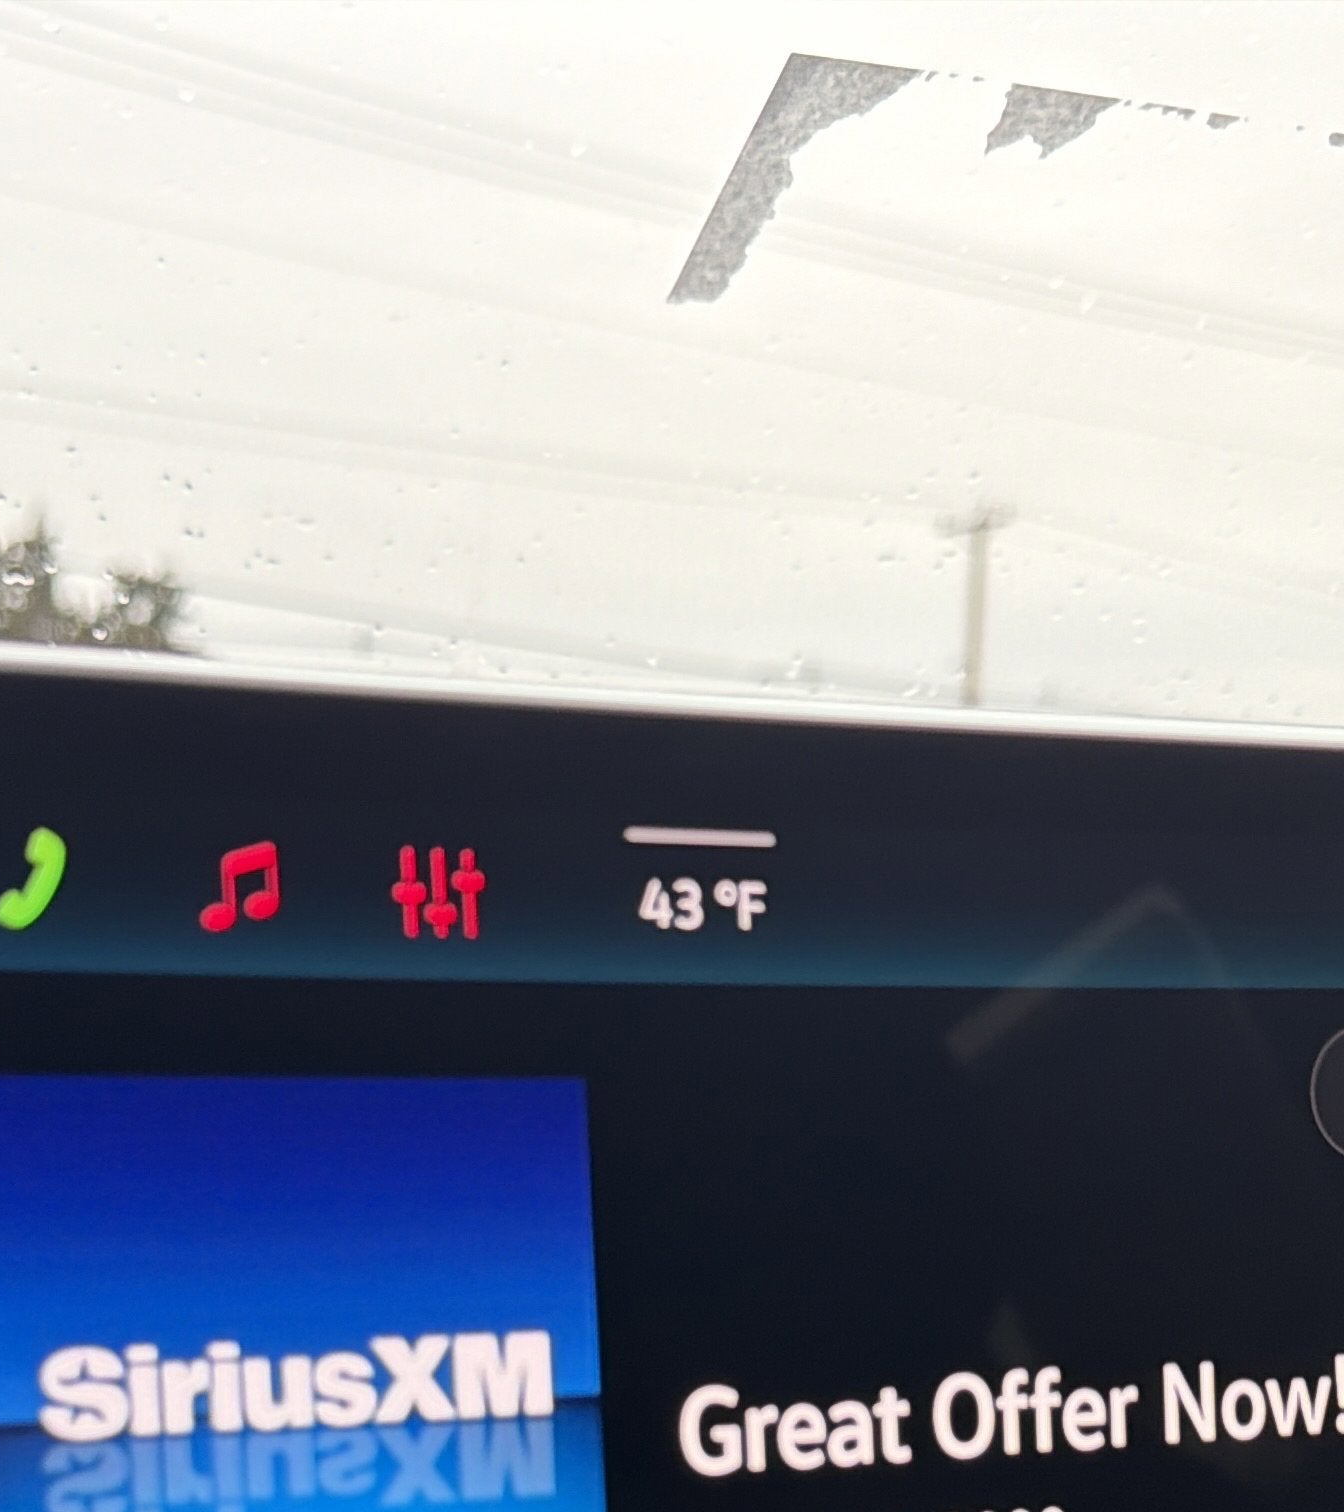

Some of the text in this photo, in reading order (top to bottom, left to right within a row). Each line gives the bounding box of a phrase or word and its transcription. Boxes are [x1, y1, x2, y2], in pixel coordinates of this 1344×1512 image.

[638, 877, 705, 932] 43
[37, 1329, 557, 1443] SiriusXM
[678, 1383, 914, 1478] Great
[931, 1365, 1140, 1461] Offer
